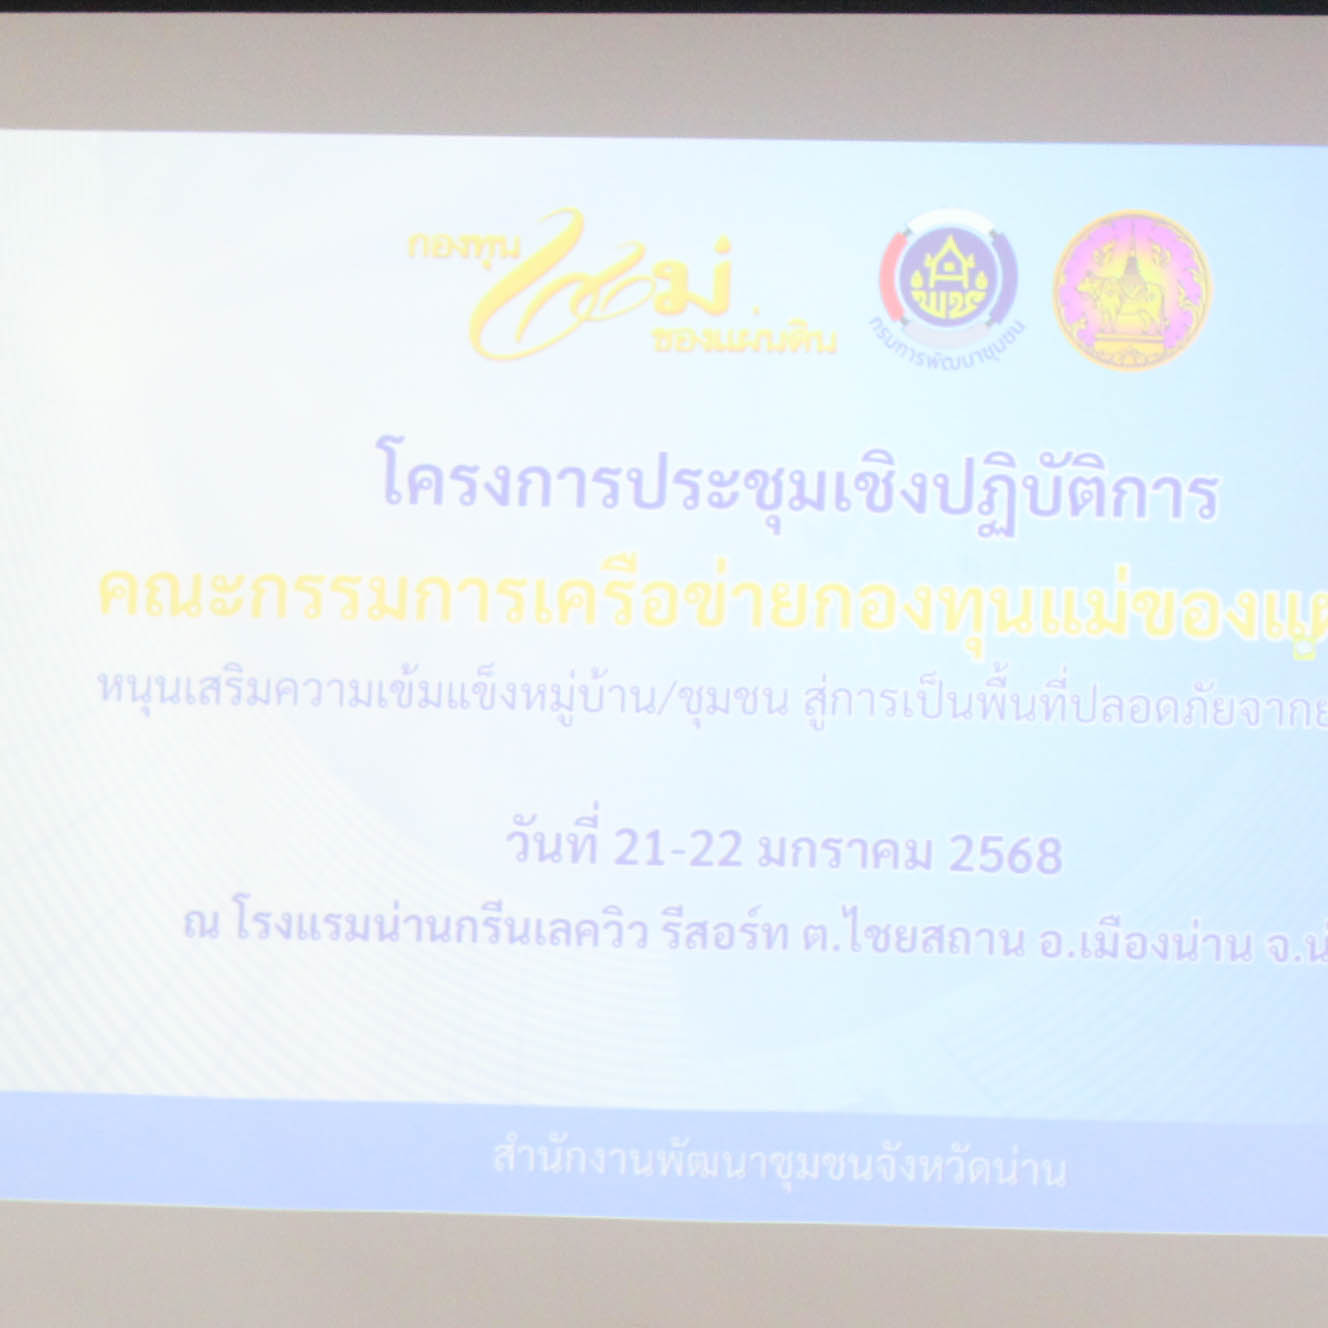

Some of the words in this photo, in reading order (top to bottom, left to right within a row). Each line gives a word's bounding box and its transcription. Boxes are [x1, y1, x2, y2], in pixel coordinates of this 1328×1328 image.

[407, 233, 521, 271] กองทุน
[375, 434, 1219, 538] โครงการประชุมเชิงปฏิบัติการ
[97, 662, 790, 730] หนุนเสริมความเข้มแข็งหมู่บ้าน/ชุมชน
[506, 800, 599, 864] วันที่
[612, 828, 744, 868] 21-22
[757, 832, 933, 872] มกราคม
[948, 834, 1064, 875] 2568
[183, 909, 220, 939] ณ
[232, 892, 649, 950] โรงแรมน่านกรีนเลควิว
[661, 904, 789, 953] รีสอร์ท
[802, 905, 1025, 958] ต.ไชยสถาน
[1039, 915, 1254, 963] อ.เมืองน่าน
[491, 1130, 1069, 1193] สำนักงานพัฒนาชุมชนจังหวัดน่าน
